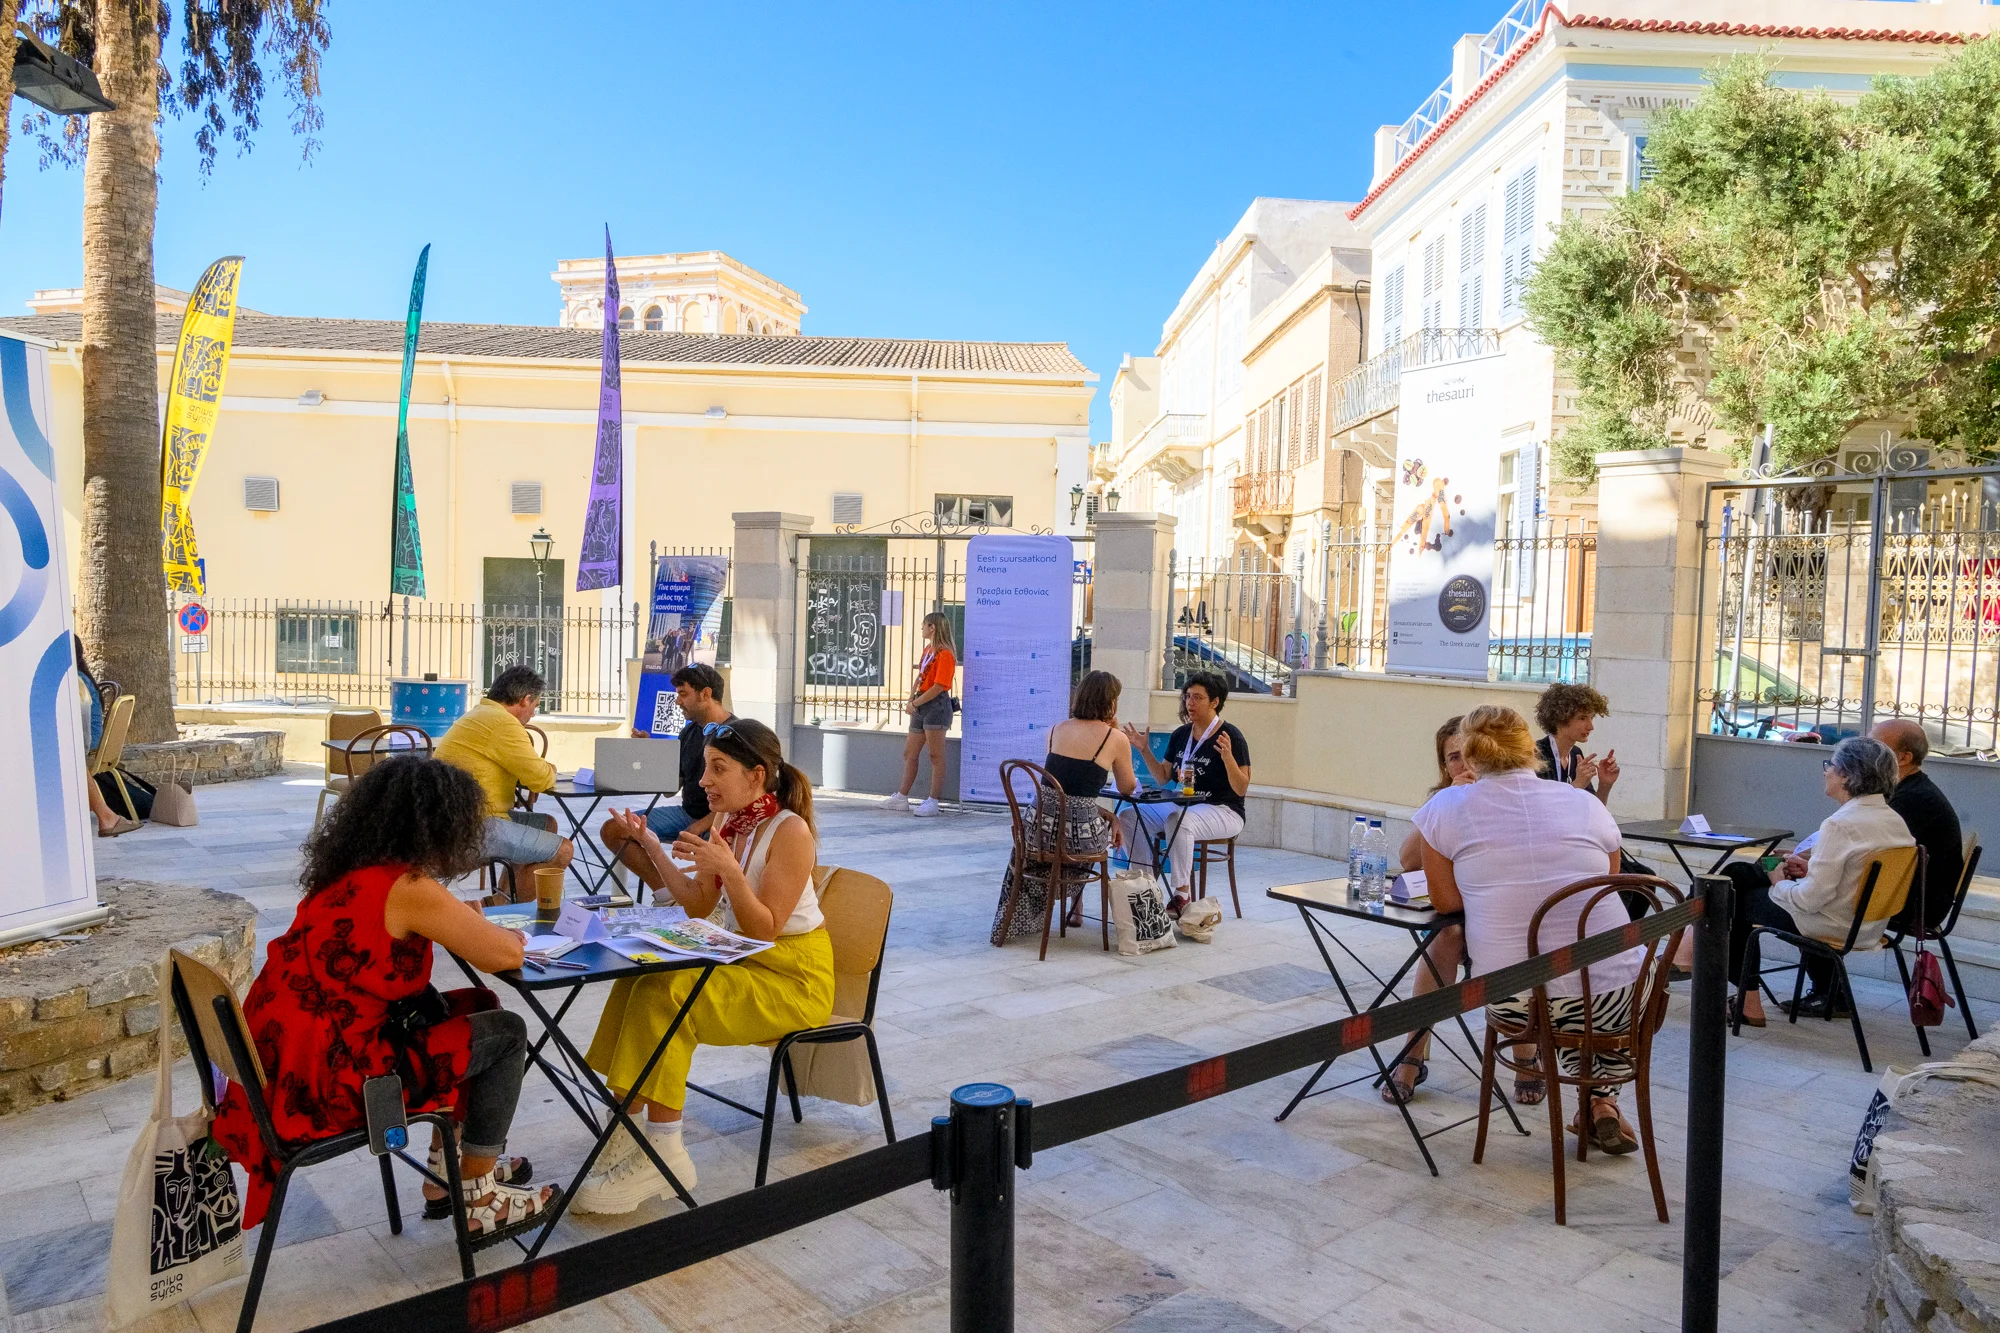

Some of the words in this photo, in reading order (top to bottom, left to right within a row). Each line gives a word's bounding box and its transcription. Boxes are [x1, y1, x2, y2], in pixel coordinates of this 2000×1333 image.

[1426, 384, 1474, 404] thesauri
[977, 554, 998, 563] Eesti
[1000, 554, 1057, 563] suursaatkond
[976, 565, 1007, 574] Ateena
[669, 583, 691, 593] σήμερα
[976, 587, 1012, 596] Πρεσβεία
[1014, 587, 1050, 597] Εσθονίας
[656, 593, 674, 602] μέλος
[673, 594, 684, 602] της
[1448, 589, 1476, 598] thesauri
[976, 598, 1001, 607] Αθήνα
[1449, 640, 1464, 648] Greek
[1197, 755, 1212, 766] day
